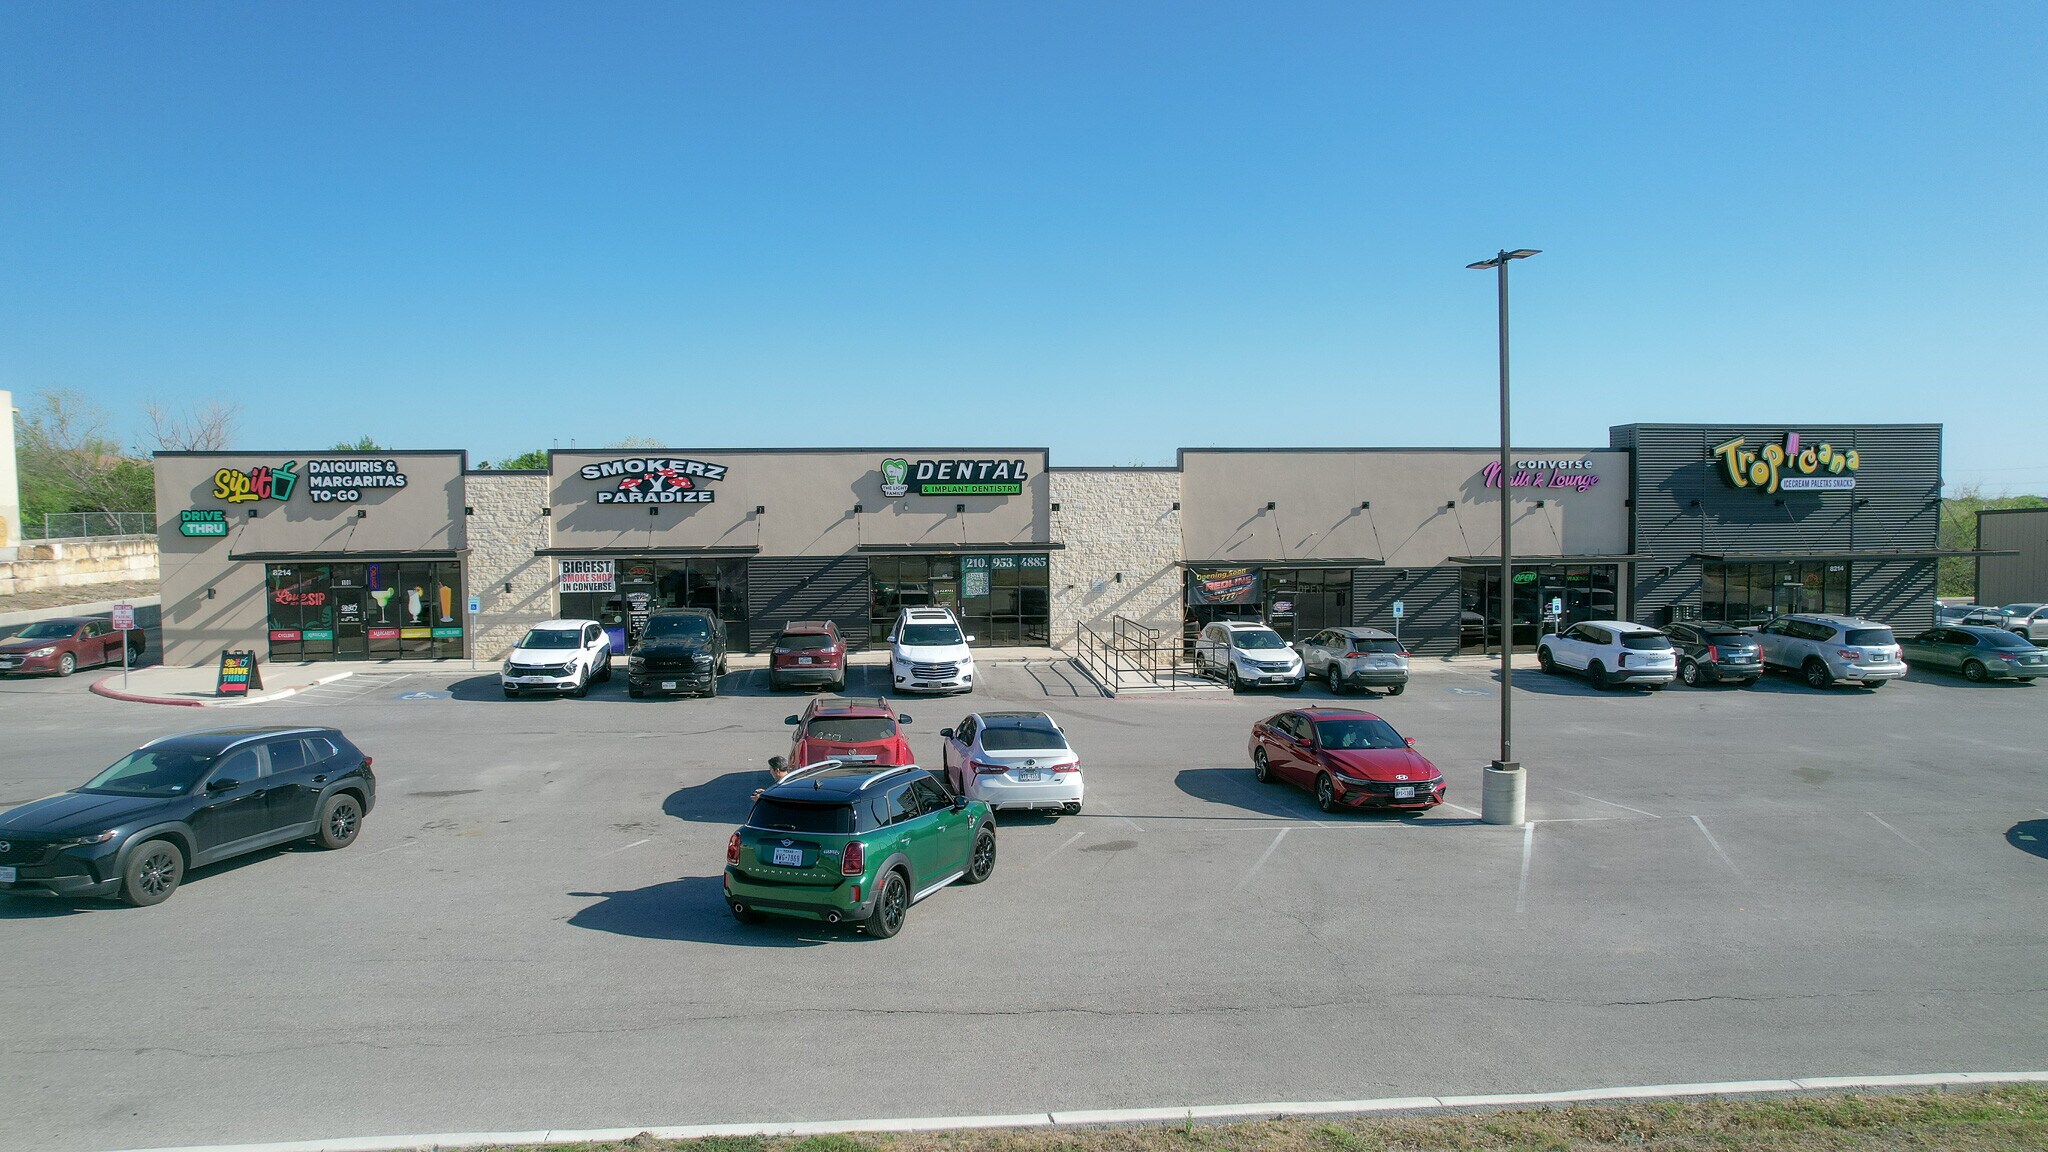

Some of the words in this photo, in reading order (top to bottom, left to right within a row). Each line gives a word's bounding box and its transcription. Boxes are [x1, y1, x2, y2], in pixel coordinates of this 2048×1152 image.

[310, 461, 382, 473] DAIQUIRIS
[386, 460, 396, 473] &
[1517, 460, 1592, 469] converse
[1713, 432, 1860, 494] Tropicana
[581, 459, 726, 480] SMOKERZ
[916, 462, 1027, 480] DENTAL
[310, 475, 405, 487] MARGARITAS
[1483, 461, 1530, 488] Nils
[1532, 471, 1543, 488] &
[1547, 468, 1600, 493] Lounge
[1811, 479, 1832, 488] PALETAS
[1833, 479, 1853, 488] SNACKS
[311, 490, 359, 501] TO-GO
[598, 491, 712, 503] PARADIZE
[181, 511, 223, 521] DRIVE
[186, 523, 223, 534] THRU
[562, 560, 611, 573] BIGGEST
[966, 558, 988, 568] 210.
[992, 557, 1016, 568] 953.
[1020, 557, 1047, 567] 4885
[562, 574, 589, 582] SMOKE
[591, 573, 612, 582] SHOP
[1197, 572, 1227, 581] Opening
[1514, 574, 1534, 582] OPEN
[563, 583, 571, 591] IN
[573, 582, 612, 591] CONVERSE
[1205, 575, 1251, 592] REDLINE
[308, 592, 326, 606] SIP
[1221, 592, 1236, 601] 777
[222, 667, 249, 675] DRIVE
[223, 674, 247, 682] THRU
[748, 866, 827, 878] COUNTRYMAN
